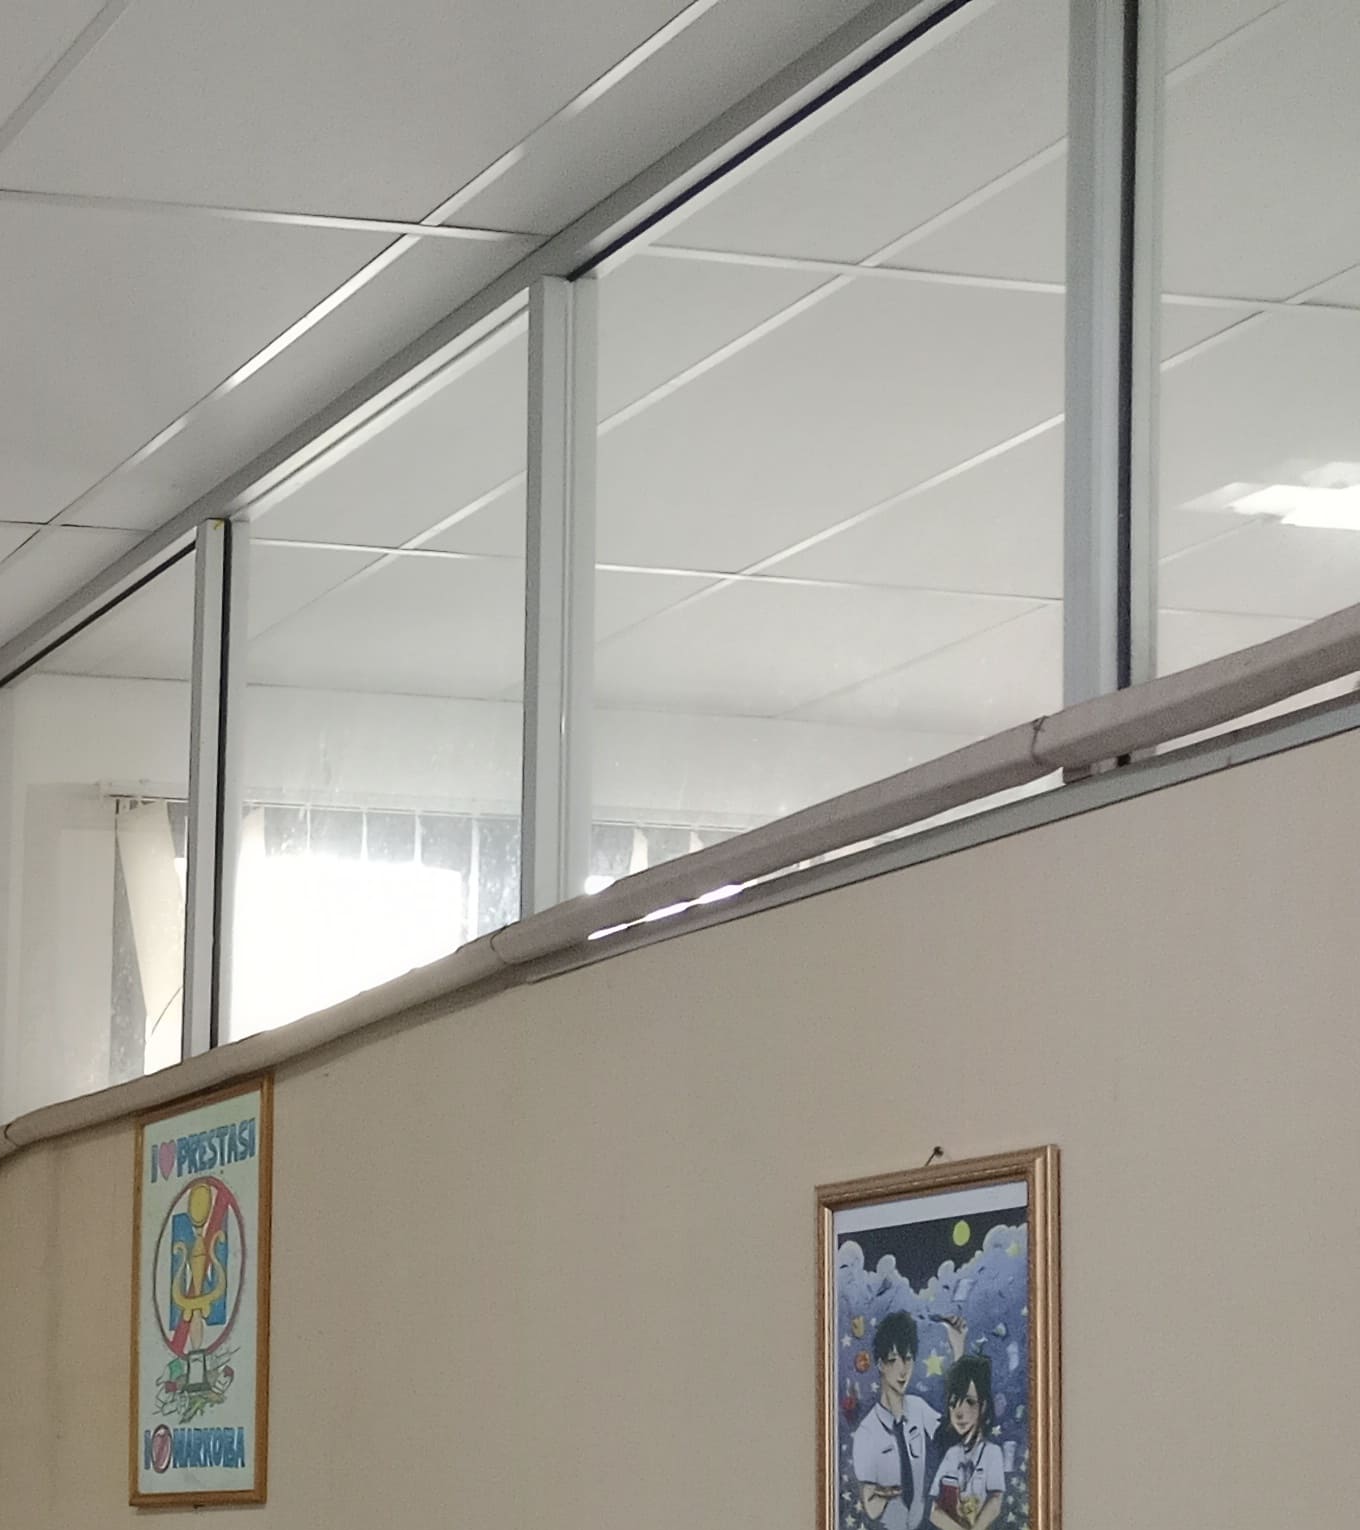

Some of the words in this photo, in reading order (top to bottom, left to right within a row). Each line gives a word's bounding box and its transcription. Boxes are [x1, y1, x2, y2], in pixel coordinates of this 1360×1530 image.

[151, 1144, 158, 1184] I
[176, 1117, 256, 1178] PRESTASI
[144, 1430, 151, 1470] I
